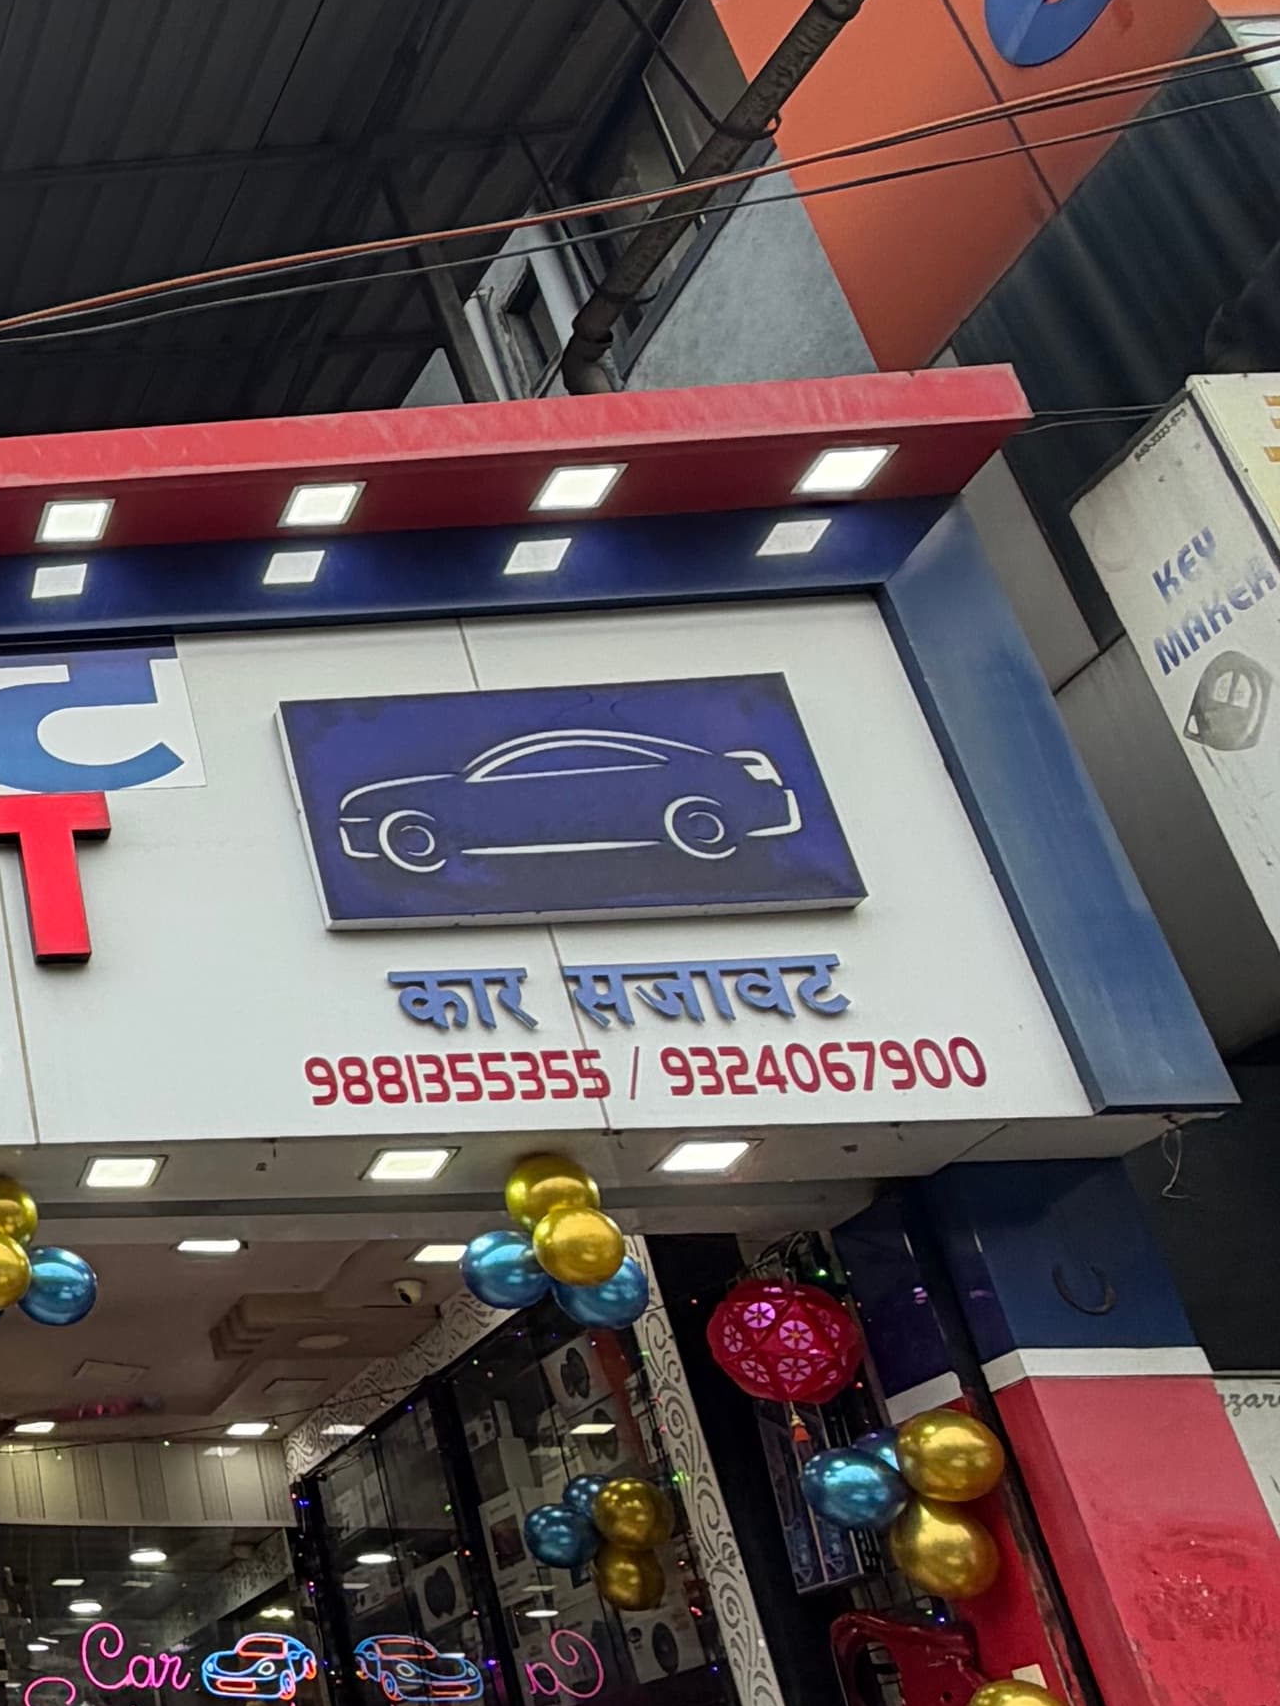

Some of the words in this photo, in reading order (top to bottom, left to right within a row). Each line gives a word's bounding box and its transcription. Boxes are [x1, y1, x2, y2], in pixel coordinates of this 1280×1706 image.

[387, 967, 539, 1029] कार
[562, 953, 851, 1028] सजावट
[304, 1048, 612, 1106] 9881355355
[659, 1037, 988, 1097] 9324067900
[80, 1621, 191, 1691] Car
